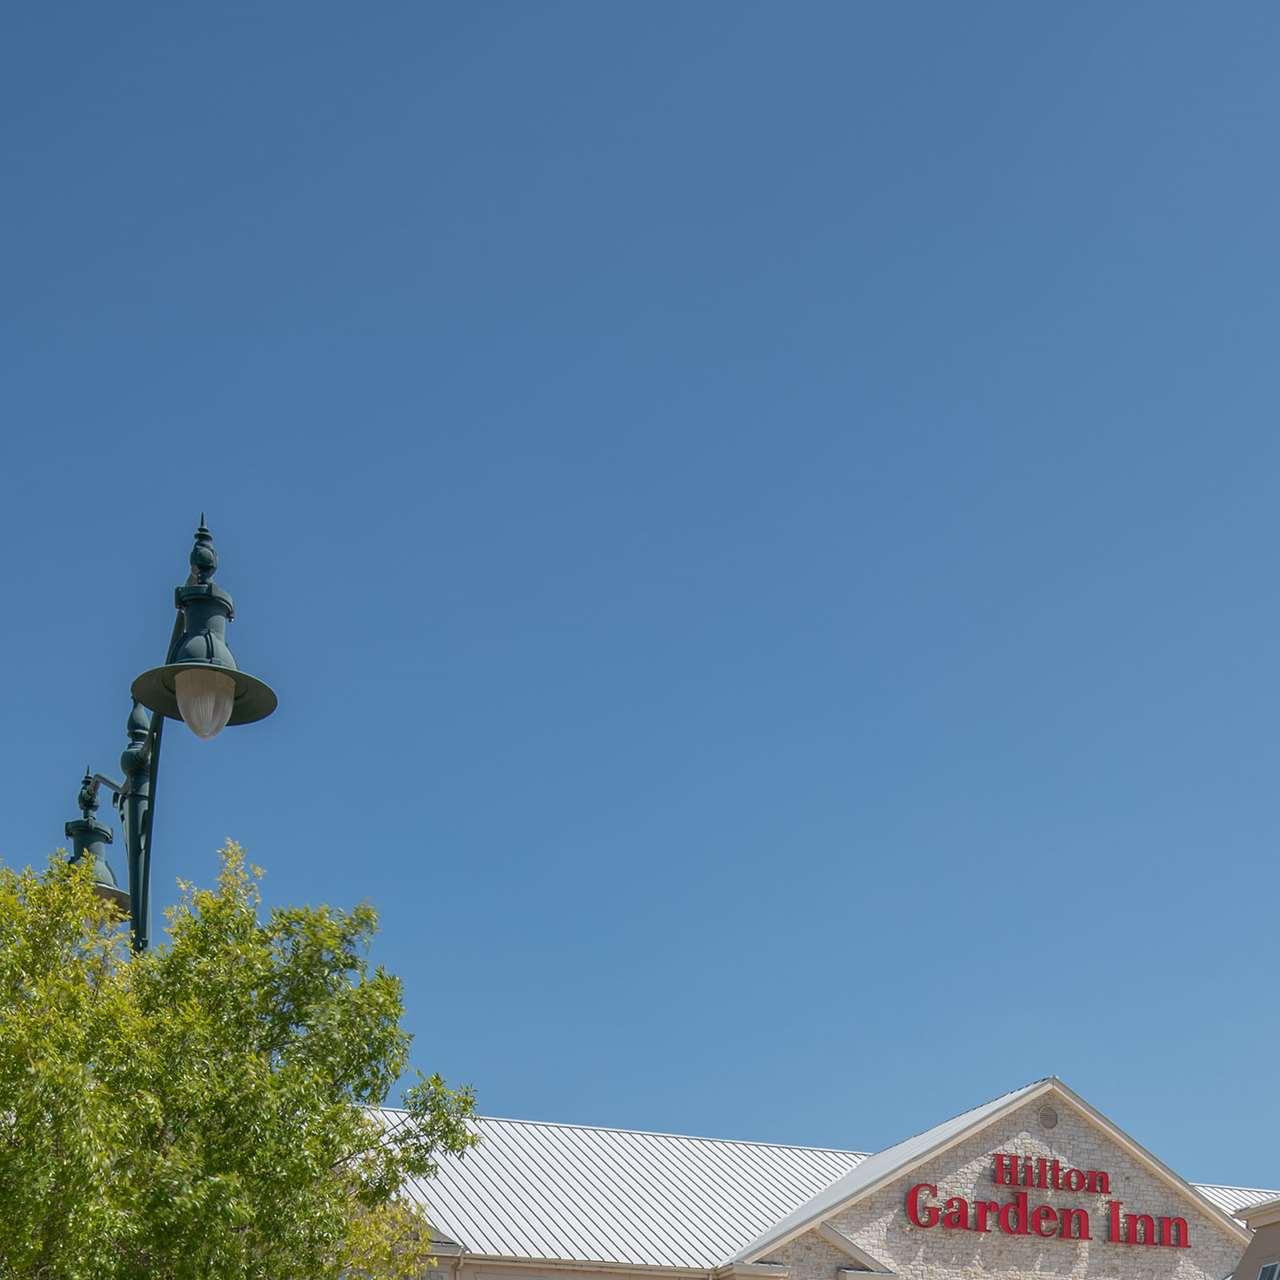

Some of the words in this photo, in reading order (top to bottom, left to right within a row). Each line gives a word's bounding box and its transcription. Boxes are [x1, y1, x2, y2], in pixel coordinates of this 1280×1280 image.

[993, 1153, 1111, 1194] Hilton
[905, 1183, 1093, 1241] Garden
[1107, 1200, 1191, 1248] Inn
